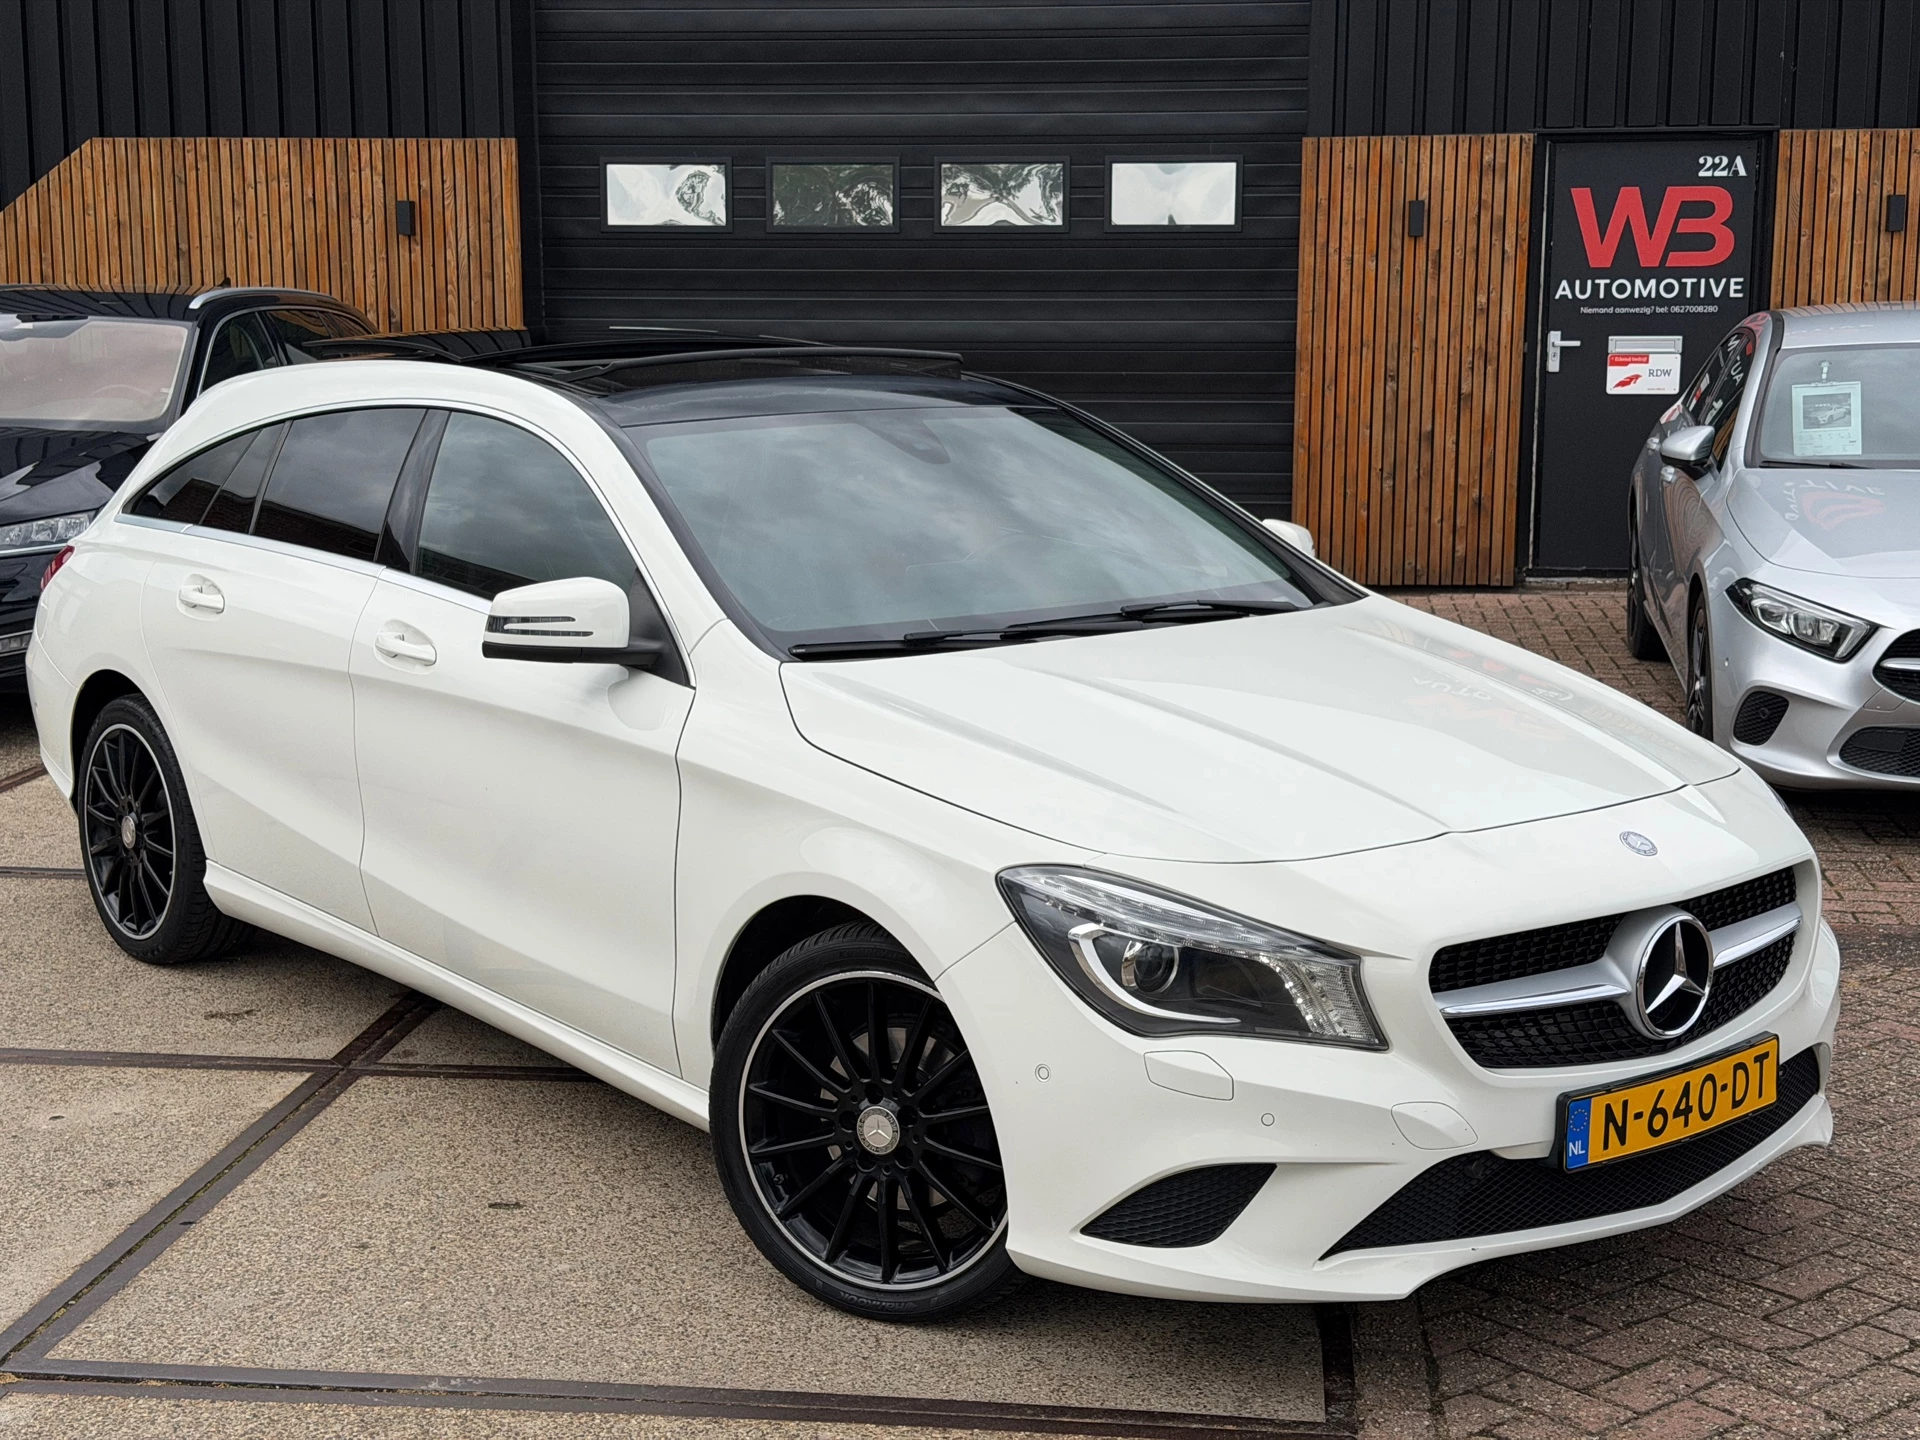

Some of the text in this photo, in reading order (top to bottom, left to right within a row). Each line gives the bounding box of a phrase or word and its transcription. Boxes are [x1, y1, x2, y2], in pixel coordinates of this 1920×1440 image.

[1698, 155, 1747, 177] 22A
[1570, 185, 1735, 268] WB
[1554, 277, 1744, 299] AUTOMOTIVE
[1580, 306, 1613, 314] Niemand
[1615, 306, 1654, 315] aanwezig?
[1648, 368, 1672, 377] RDW
[1602, 1050, 1770, 1151] N-640-DT
[1568, 1140, 1586, 1157] NL
